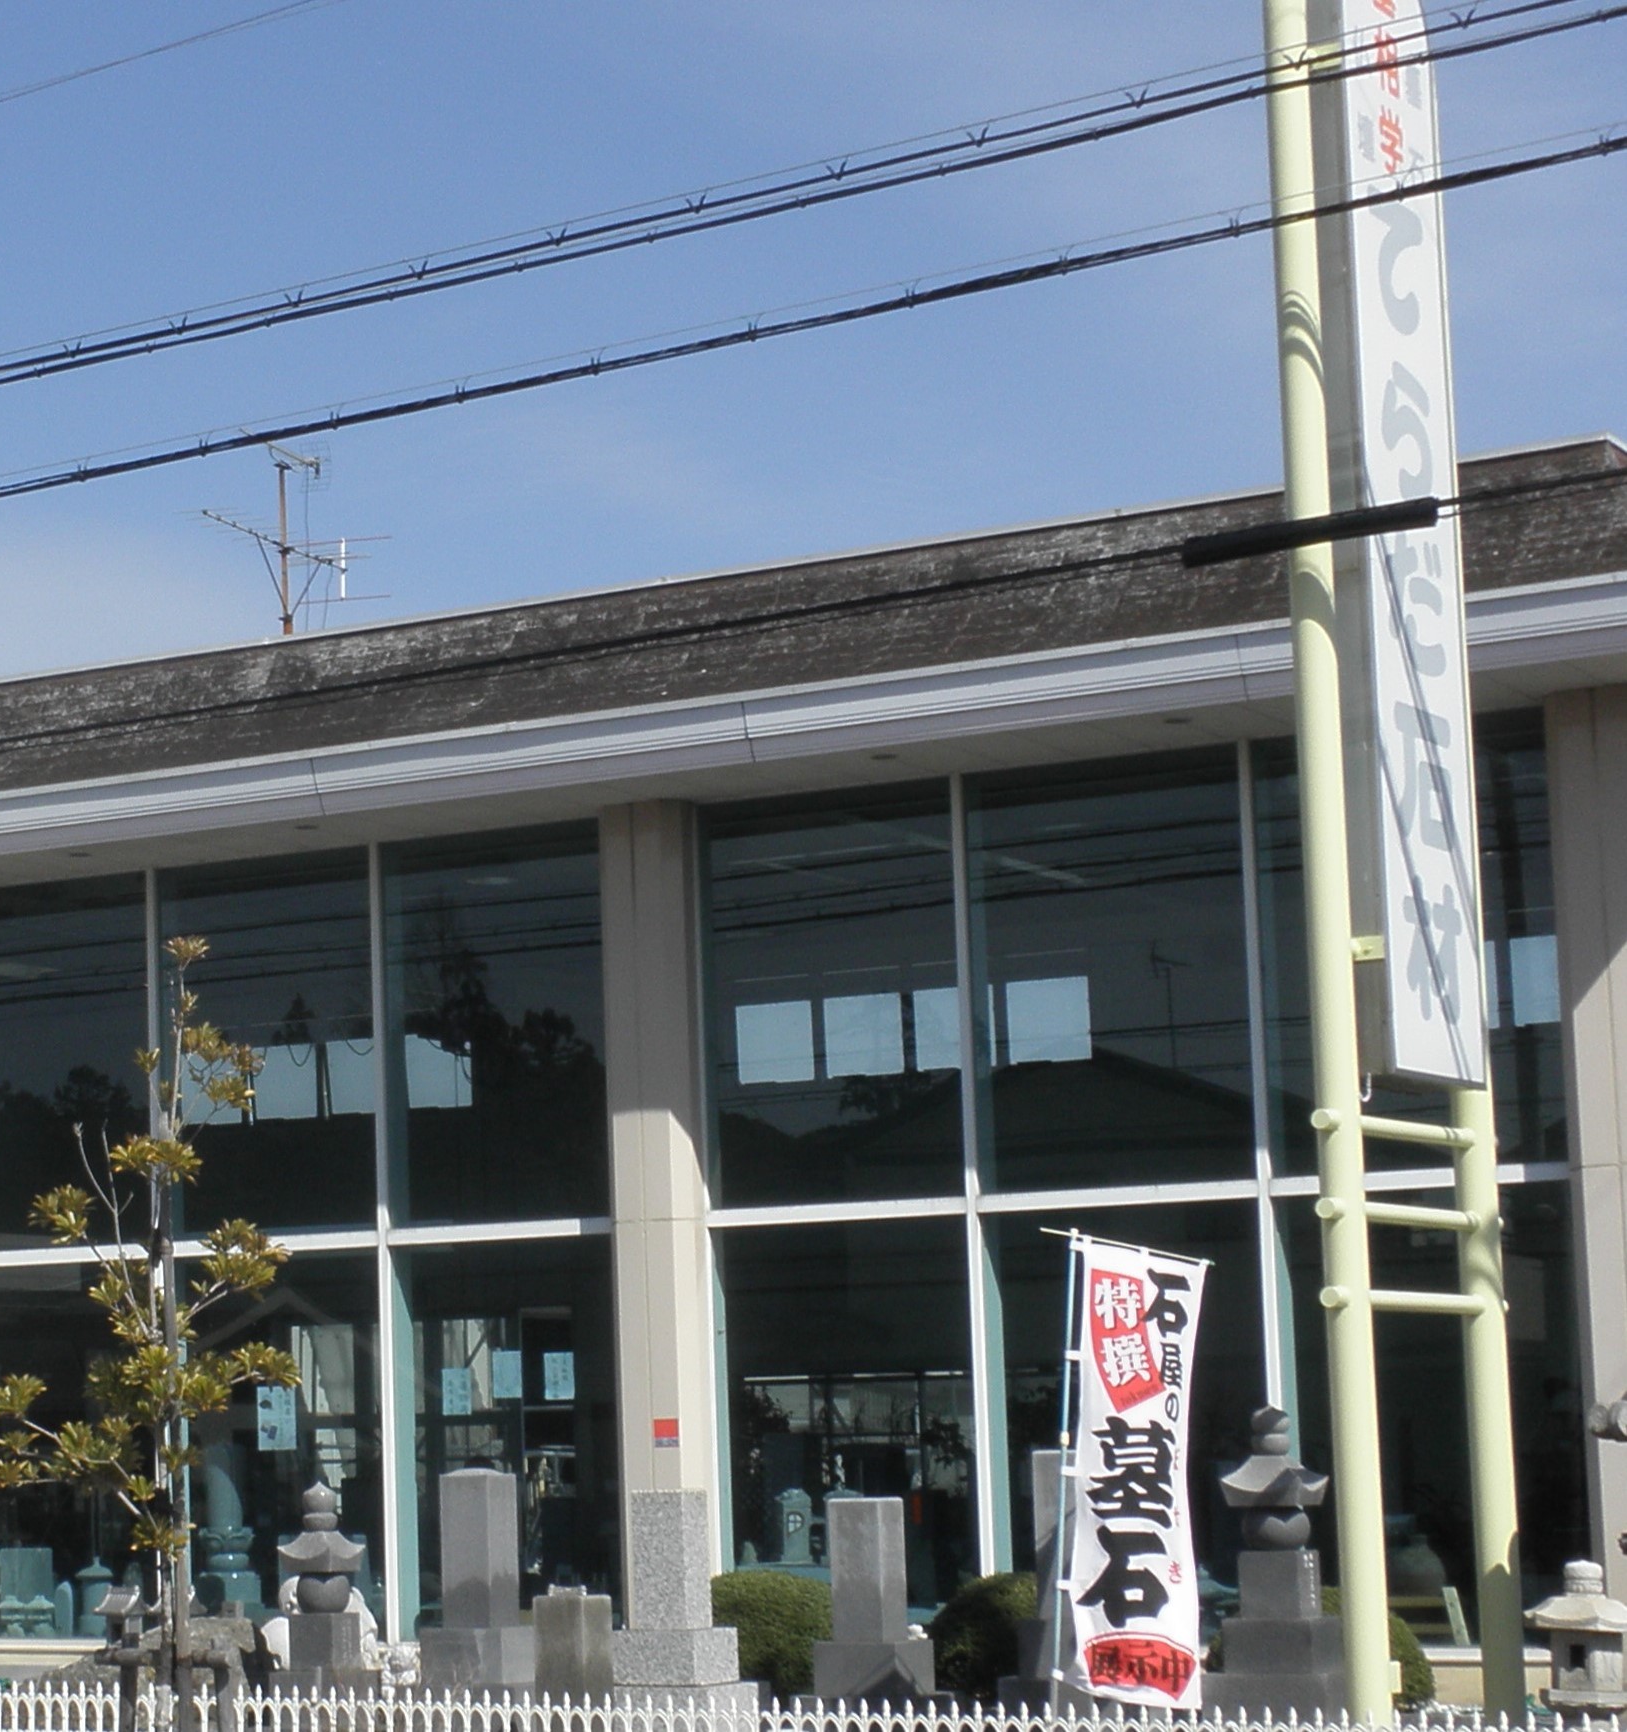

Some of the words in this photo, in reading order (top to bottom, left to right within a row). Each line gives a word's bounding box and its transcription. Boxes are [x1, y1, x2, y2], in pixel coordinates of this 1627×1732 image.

[1093, 1277, 1152, 1389] 特撰
[1142, 1268, 1191, 1421] 石屋の
[1076, 1416, 1177, 1628] 墓石
[1090, 1641, 1190, 1692] 展示中
